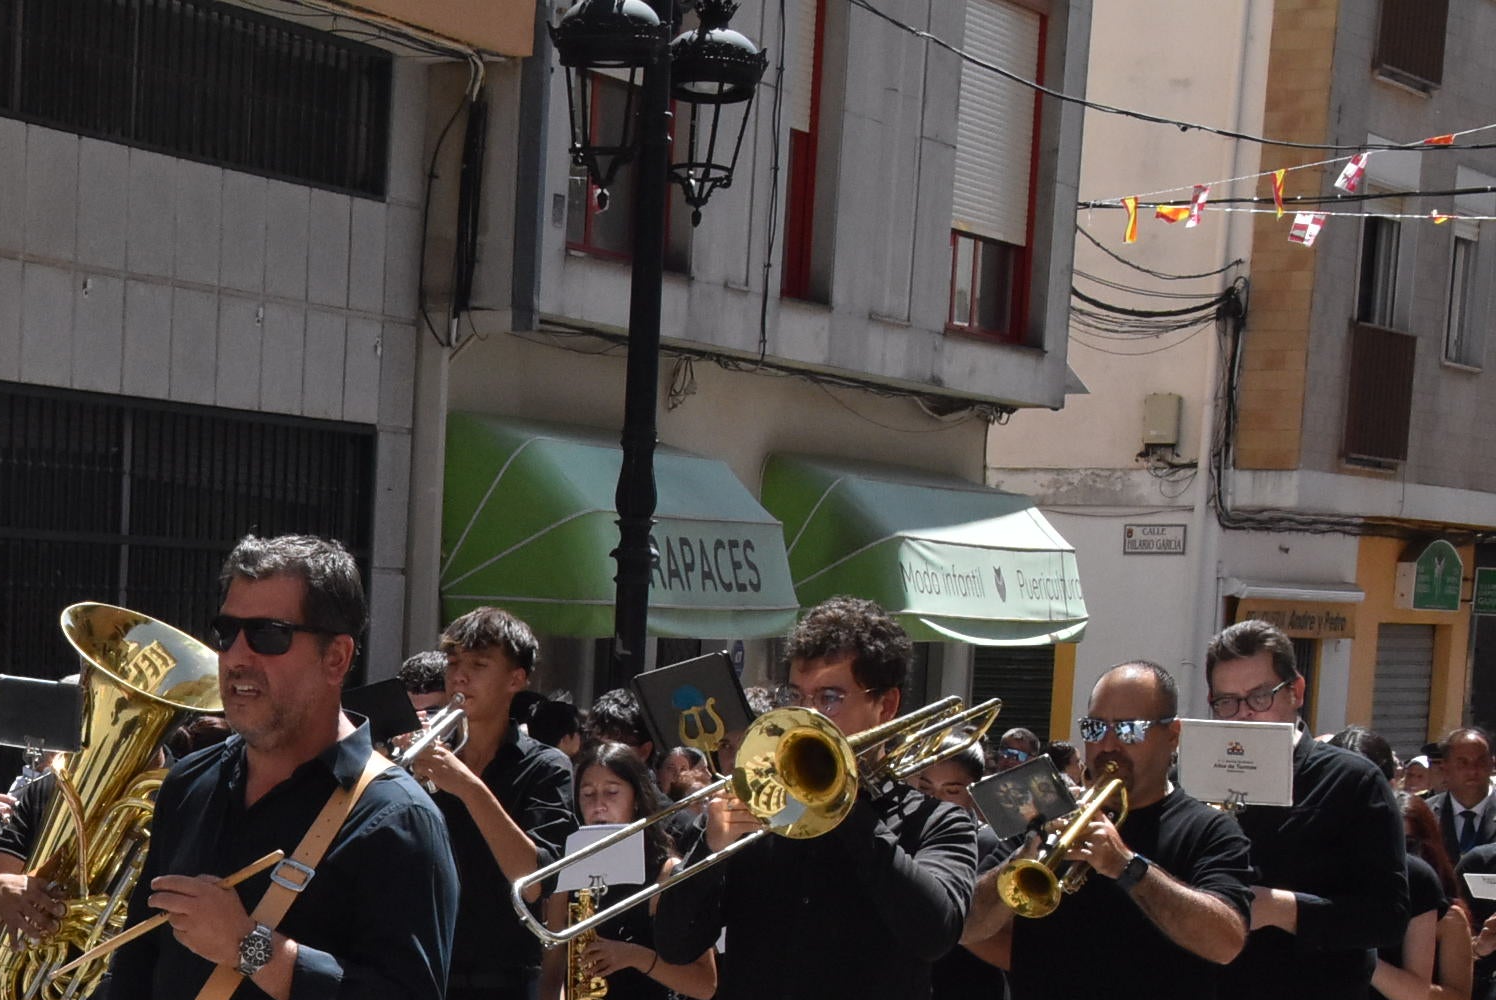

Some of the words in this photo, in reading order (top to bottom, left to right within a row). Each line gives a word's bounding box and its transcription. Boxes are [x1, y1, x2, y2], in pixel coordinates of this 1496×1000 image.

[1142, 527, 1167, 536] CALLE
[899, 561, 941, 595] Moda
[941, 564, 986, 599] infantil
